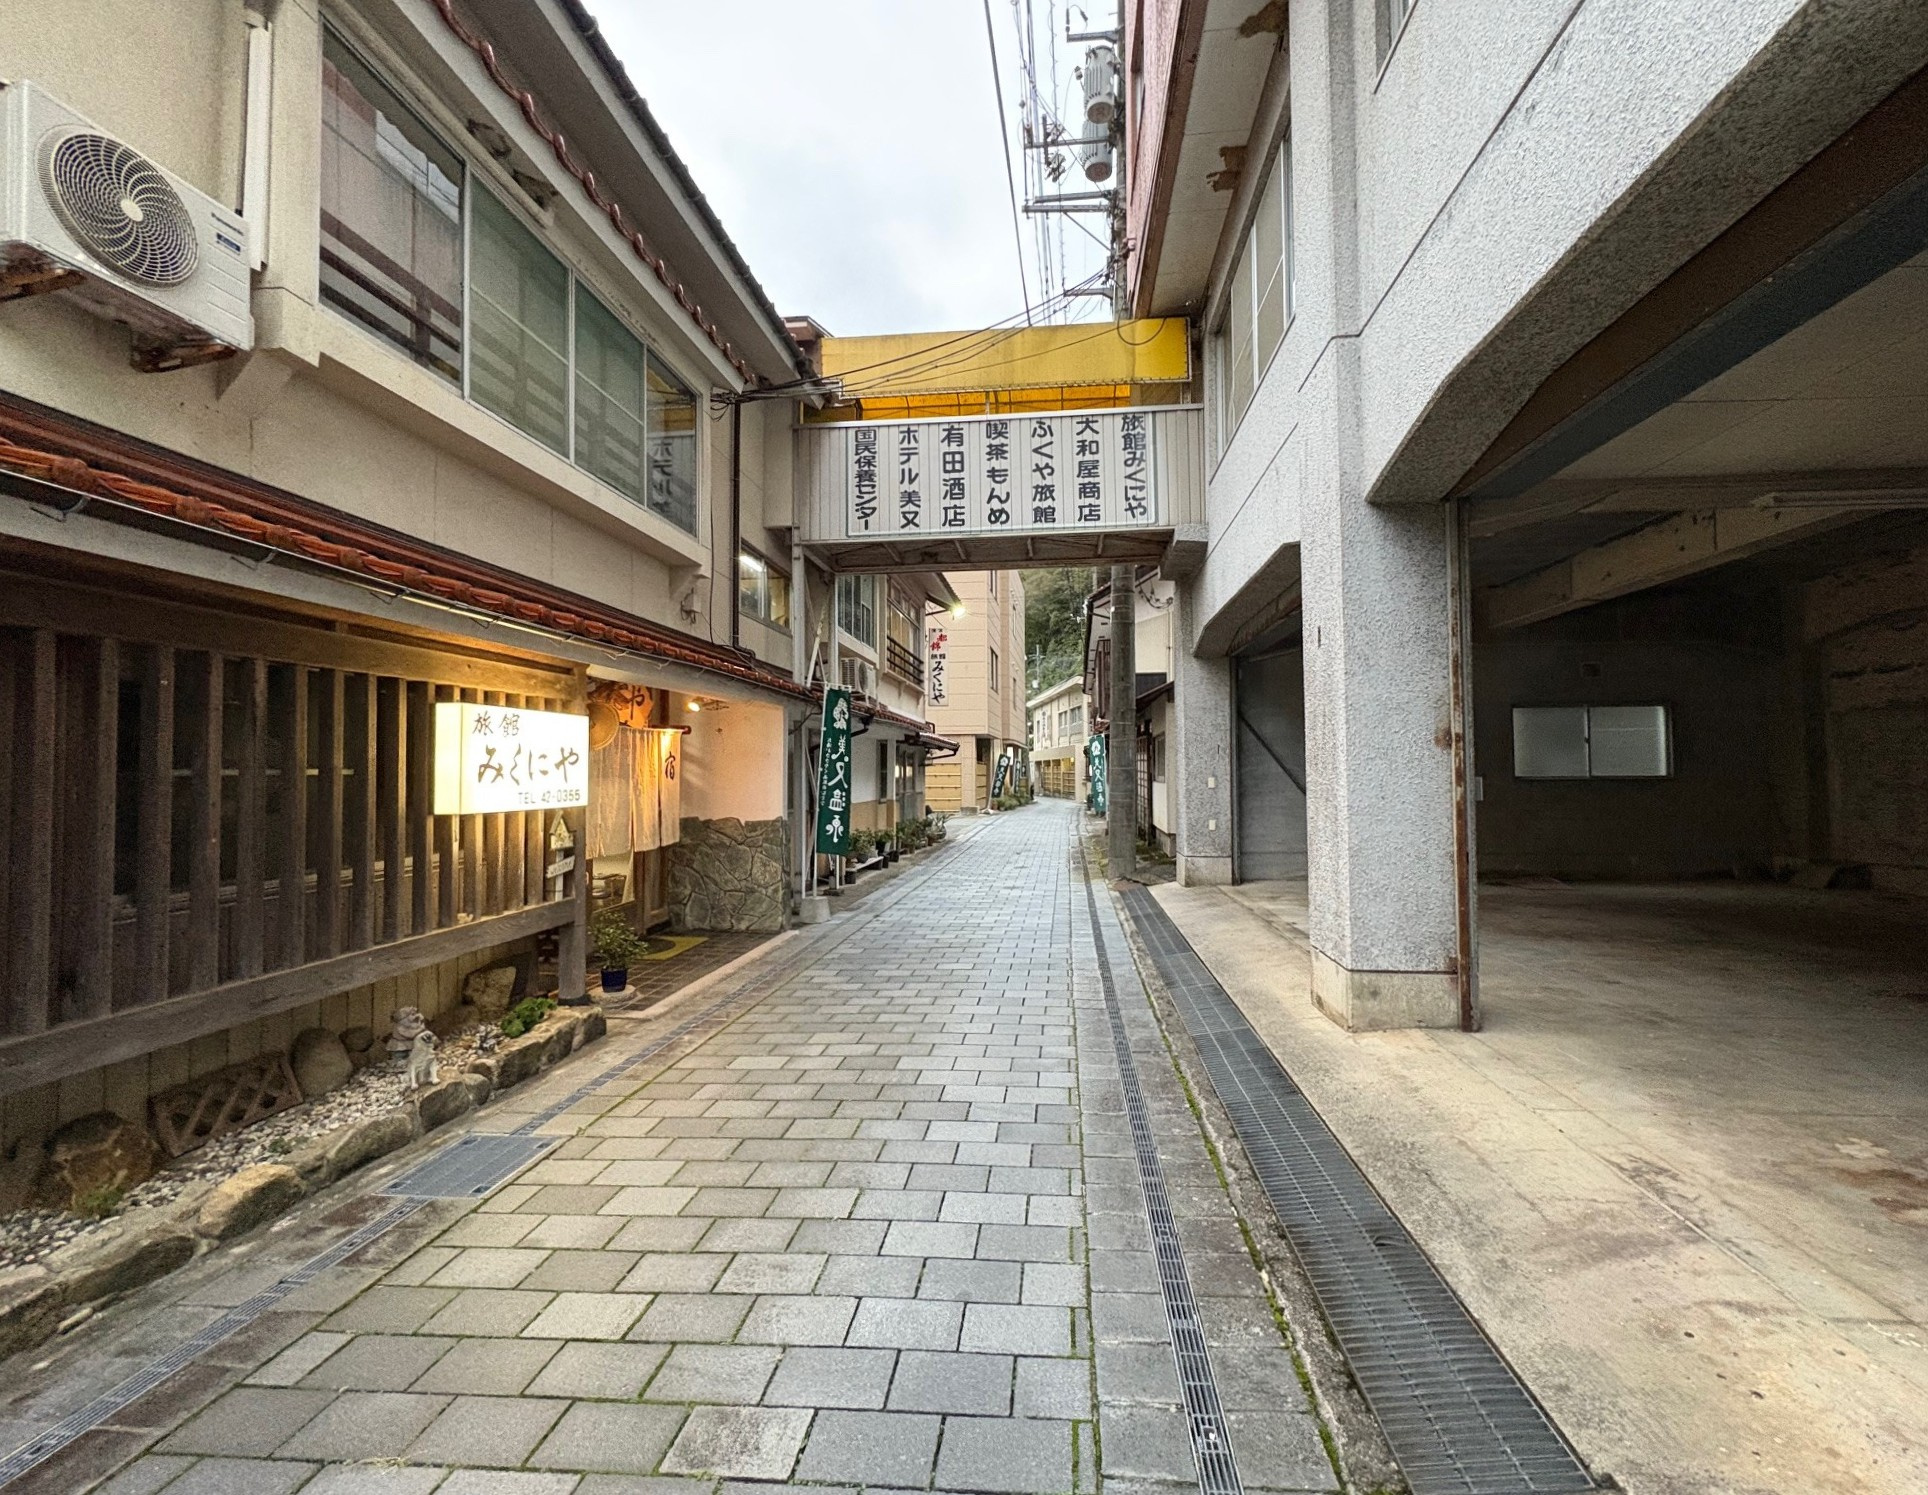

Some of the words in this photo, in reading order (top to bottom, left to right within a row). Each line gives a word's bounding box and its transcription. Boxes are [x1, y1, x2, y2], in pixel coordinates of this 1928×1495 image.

[855, 428, 878, 531] 国民保養センター
[899, 427, 922, 529] ホテル美又
[941, 424, 966, 527] 有田酒店
[985, 421, 1010, 525] 喫茶もんめ
[1032, 420, 1057, 524] ふくや旅館
[1075, 417, 1101, 522] 大和屋商店
[1121, 414, 1148, 519] 旅館みくにや
[472, 709, 521, 738] 旅館
[931, 660, 946, 704] みくにや
[477, 742, 580, 787] みくにや
[518, 791, 536, 805] TEL
[541, 788, 581, 804] 42-0355
